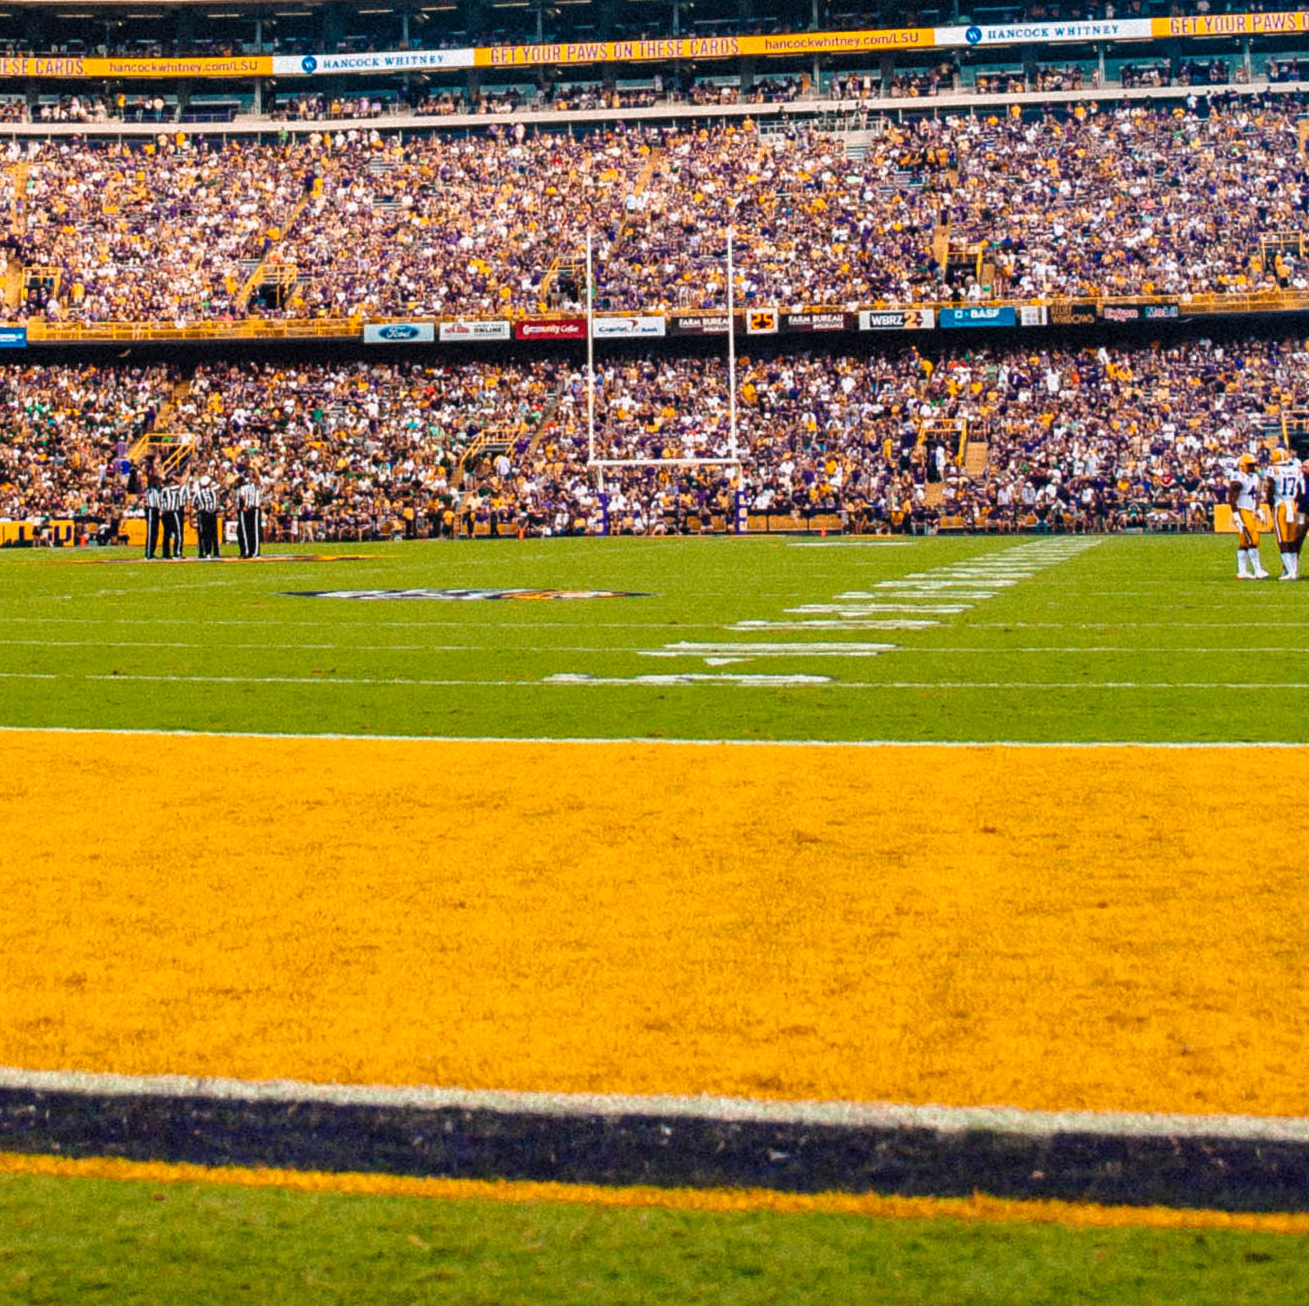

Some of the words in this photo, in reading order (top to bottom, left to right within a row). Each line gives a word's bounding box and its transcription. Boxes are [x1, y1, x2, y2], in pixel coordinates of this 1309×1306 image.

[1170, 17, 1197, 34] GET
[1204, 15, 1246, 32] YOUR
[1252, 13, 1297, 31] PAWS
[988, 28, 1049, 41] HANCOCK
[1055, 25, 1120, 38] WHITNEY
[765, 32, 920, 51] hancockwhitney.com/LSU
[491, 48, 517, 64] GET
[522, 46, 562, 62] YOUR
[567, 44, 607, 61] PAWS
[614, 42, 633, 58] ON
[639, 40, 684, 57] THESE
[690, 37, 743, 55] CARDS.
[35, 58, 89, 75] CARDS.
[109, 60, 259, 77] hancockwhitney.com/LSU
[323, 57, 381, 69] HANCOCK
[385, 54, 445, 67] WHITNEY
[703, 317, 729, 325] BUREA
[751, 312, 774, 330] 25
[812, 314, 844, 322] BUREAU
[871, 313, 903, 326] WBRZ
[903, 312, 918, 328] 2
[970, 309, 1000, 319] BASF
[385, 325, 414, 340] Ford
[1282, 477, 1296, 496] 17
